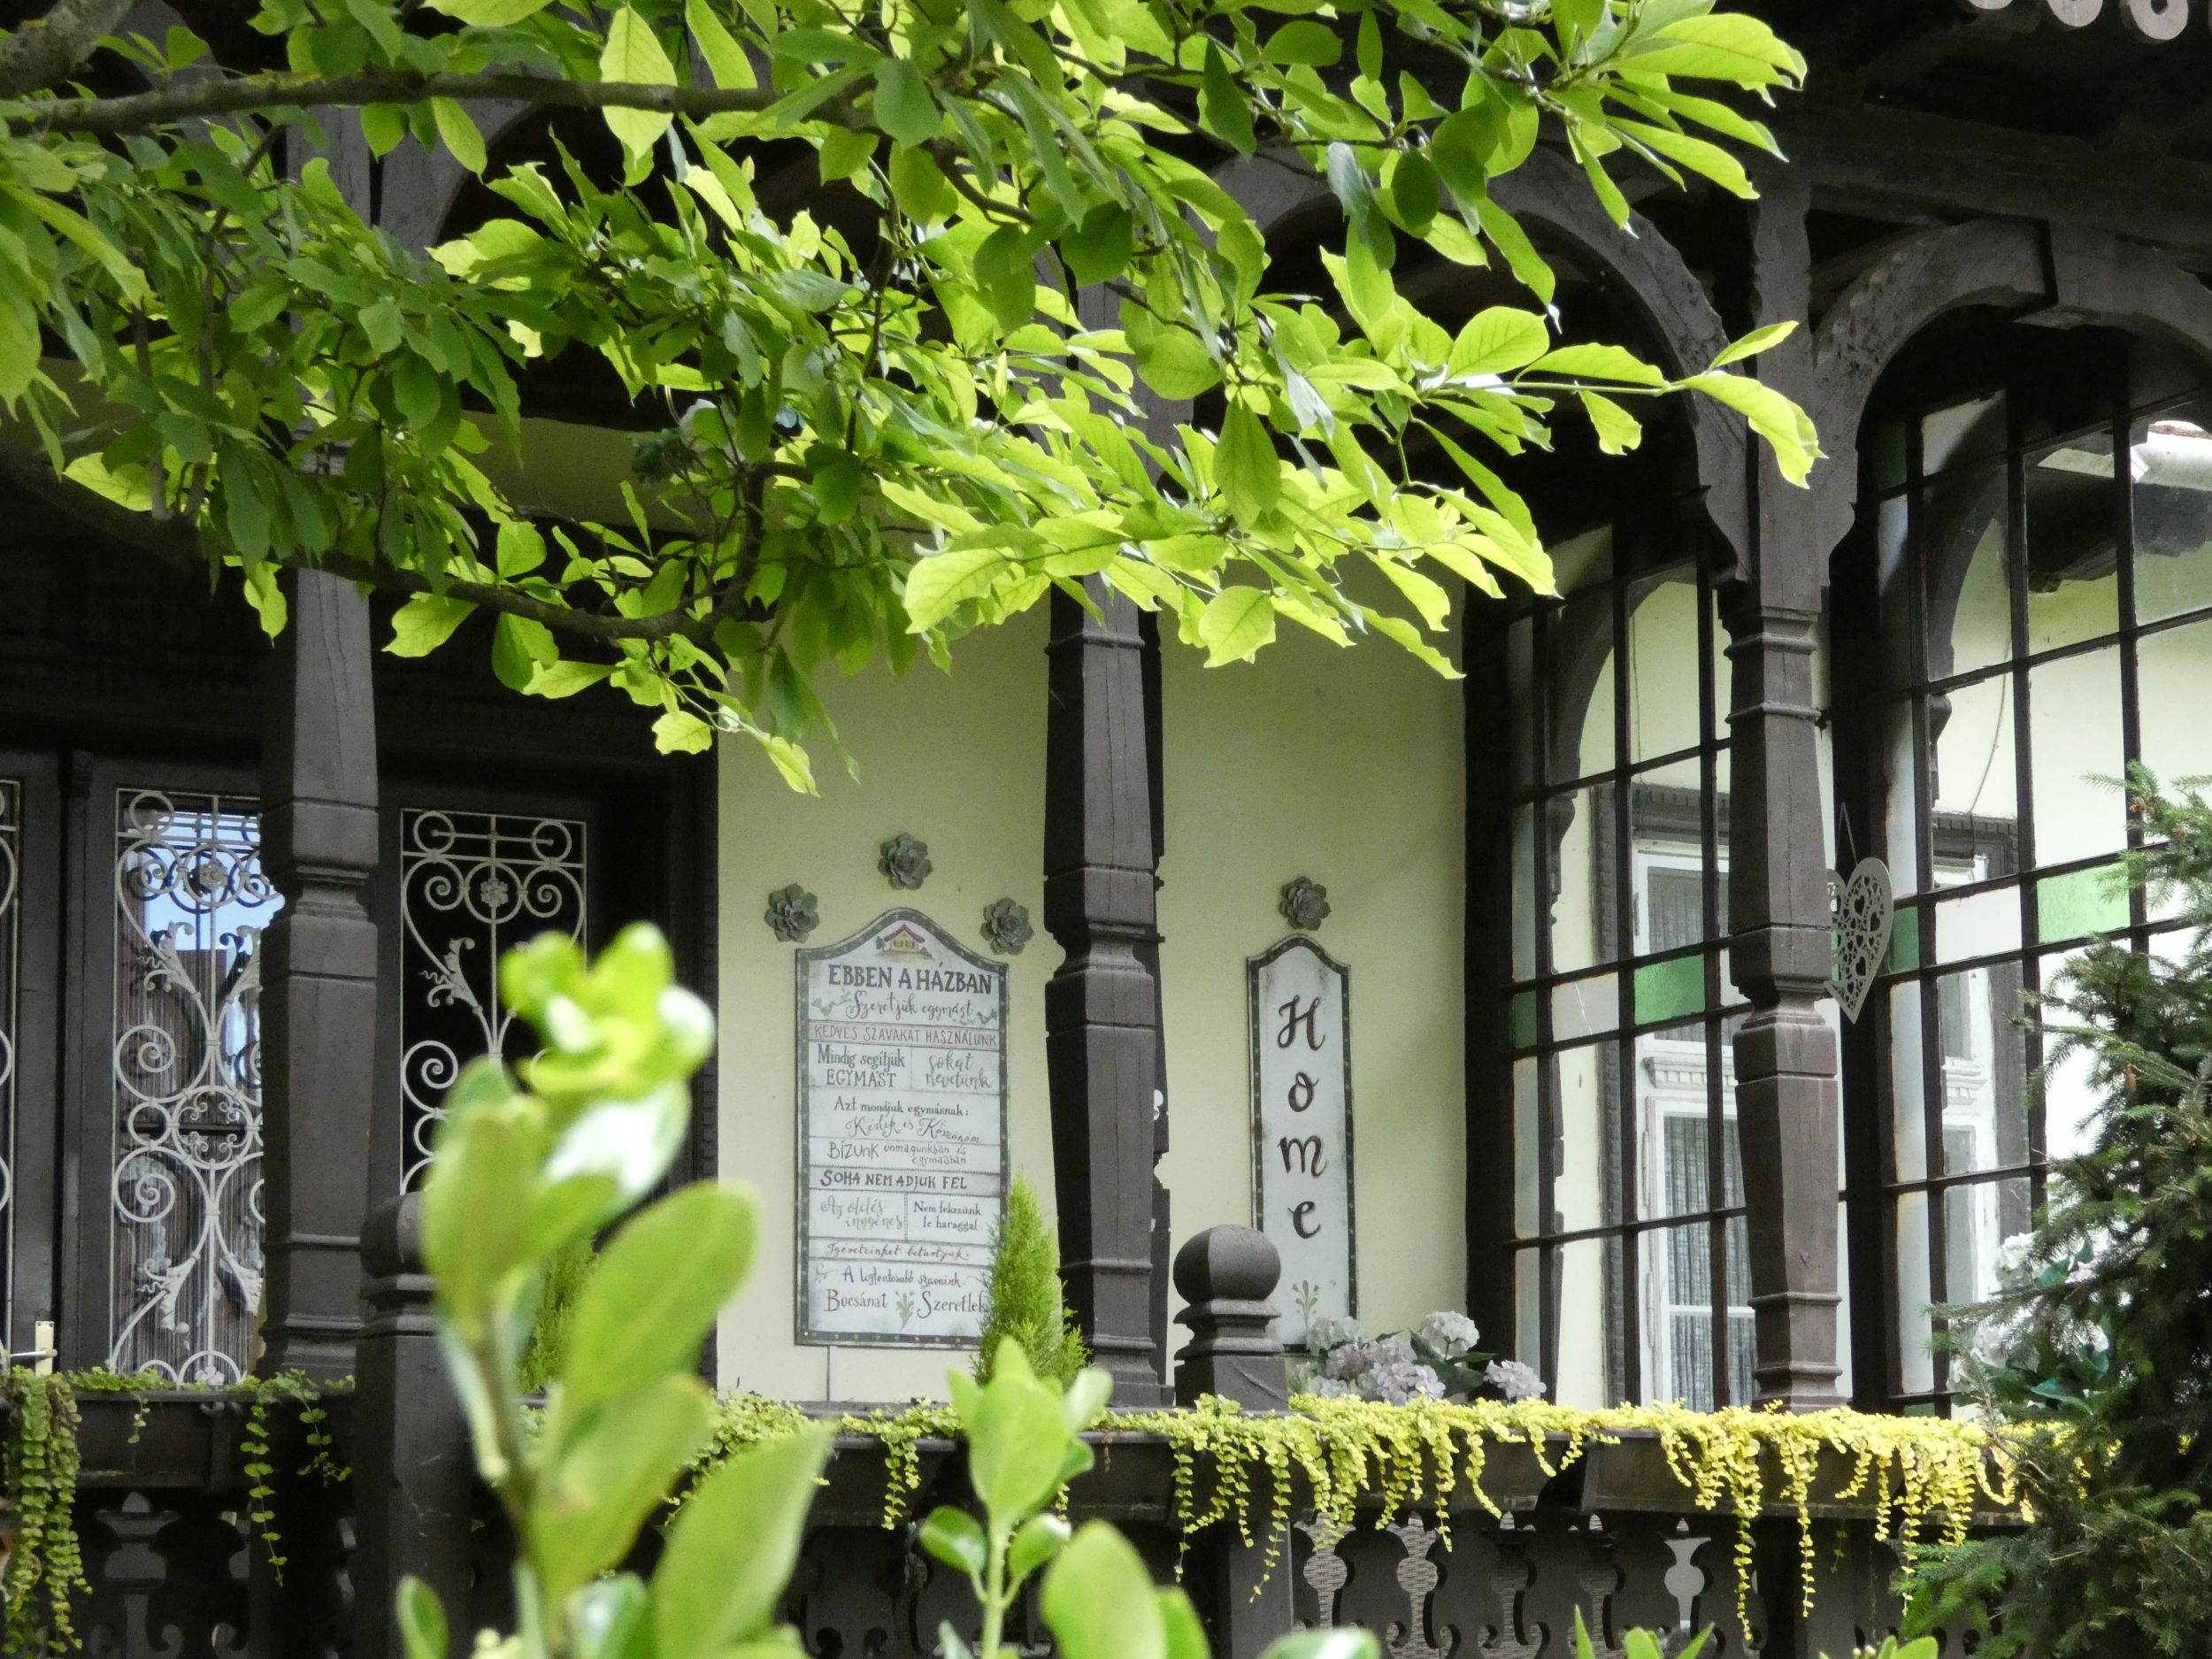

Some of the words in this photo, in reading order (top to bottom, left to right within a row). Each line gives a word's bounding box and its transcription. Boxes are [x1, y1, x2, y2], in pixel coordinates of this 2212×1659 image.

[827, 964, 892, 989] EBBEN
[898, 971, 913, 990] A
[916, 961, 993, 995] HÁZBAN
[845, 989, 918, 1021] Szeretjük
[921, 998, 973, 1022] egymást
[815, 1025, 858, 1041] KEDVES
[863, 1026, 920, 1043] SZAVAKAT
[926, 1029, 998, 1048] HASZNÁLUNK
[817, 1043, 857, 1069] Mindig
[859, 1048, 906, 1072] segítjük
[826, 1068, 897, 1088] EGYMÁST
[833, 1094, 857, 1111] Azt
[860, 1100, 904, 1117] mondjuk
[1276, 993, 1328, 1240] Home
[819, 1169, 861, 1187] SOHA
[864, 1172, 893, 1187] NEM
[895, 1174, 936, 1191] ADJUK
[942, 1175, 968, 1190] FEL
[820, 1194, 843, 1220] Az
[913, 1200, 937, 1213] Nem
[939, 1200, 982, 1216] fekszünk
[923, 1215, 933, 1228] le
[935, 1215, 978, 1233] haraggal
[842, 1265, 855, 1283] A
[823, 1288, 888, 1312] Bocsánat
